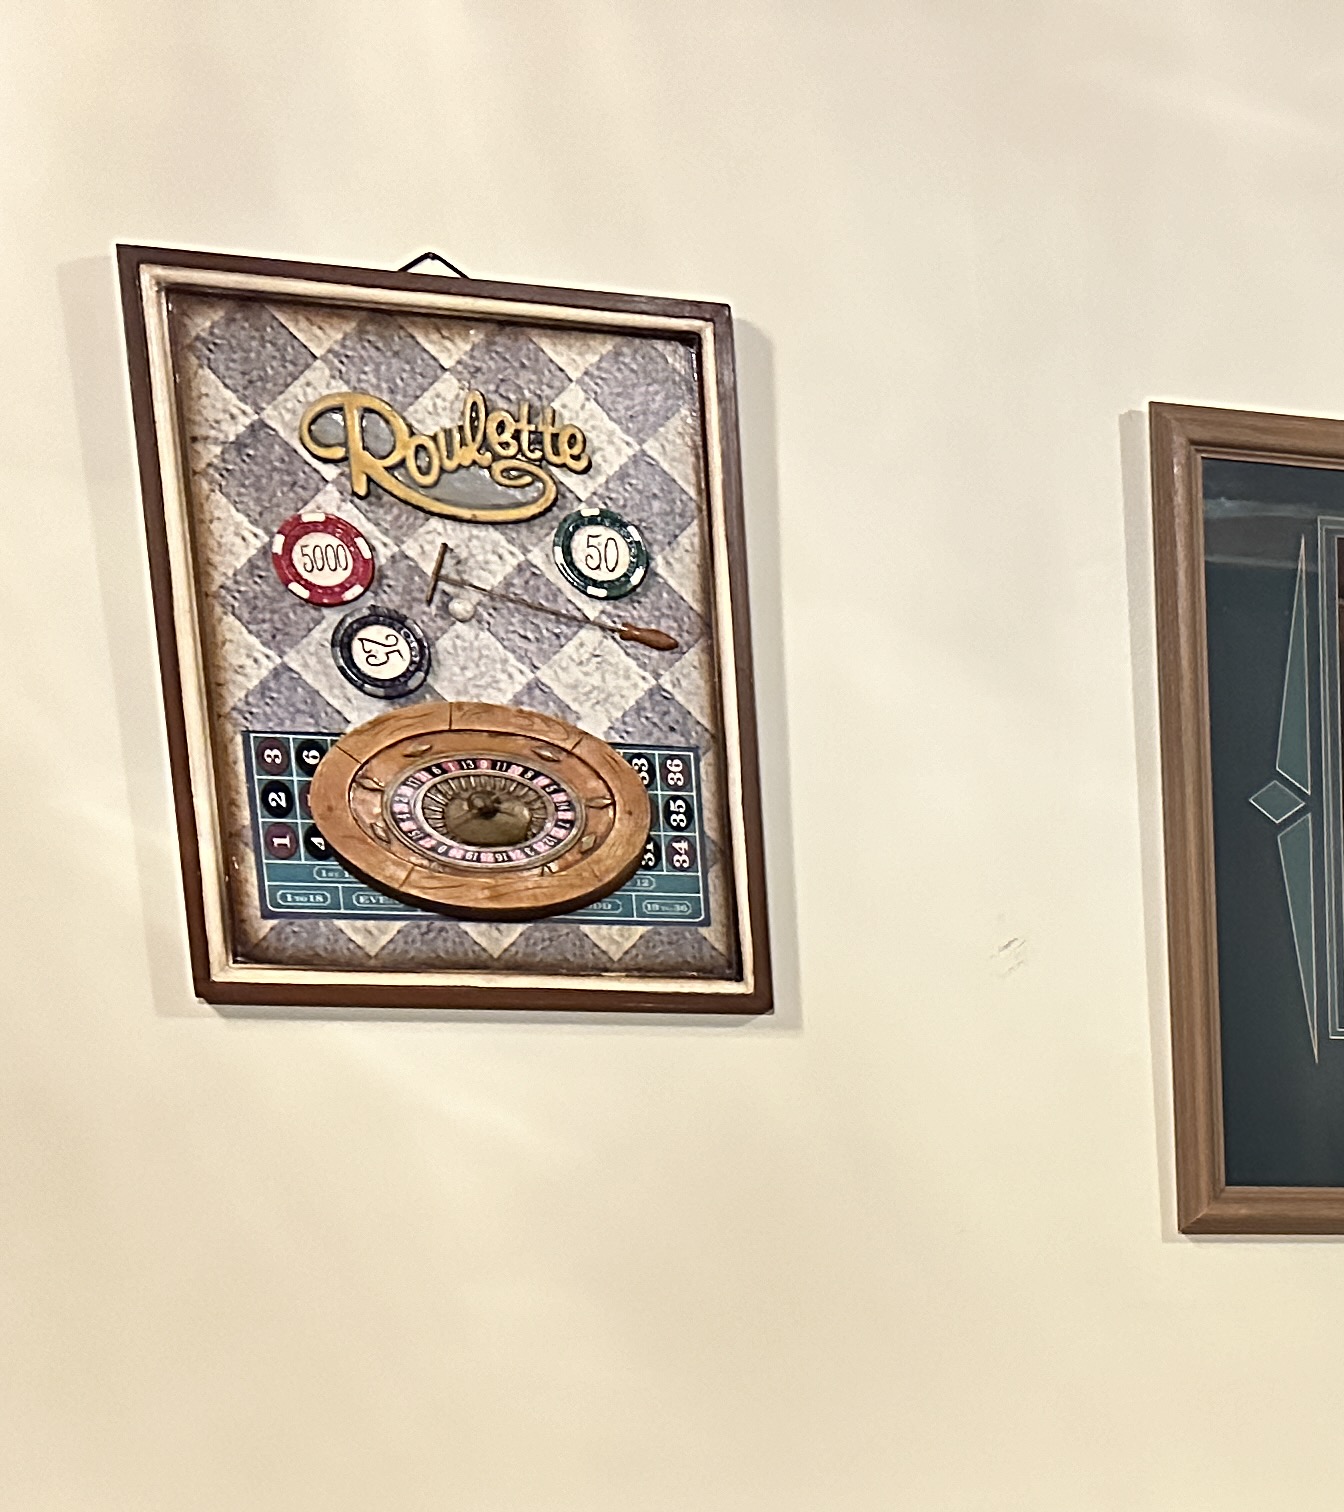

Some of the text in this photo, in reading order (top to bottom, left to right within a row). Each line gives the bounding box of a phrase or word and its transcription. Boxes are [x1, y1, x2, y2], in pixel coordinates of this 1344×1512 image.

[300, 390, 591, 523] Roulette
[300, 543, 349, 573] 5000
[585, 535, 619, 572] 50
[357, 634, 406, 667] 25
[264, 748, 282, 764] 3
[302, 750, 320, 765] 6
[461, 760, 475, 770] 13
[666, 759, 684, 786] 36
[268, 791, 287, 808] 2
[670, 799, 687, 828] 35
[272, 835, 292, 849] 1
[310, 837, 326, 851] 4
[673, 840, 690, 868] 34
